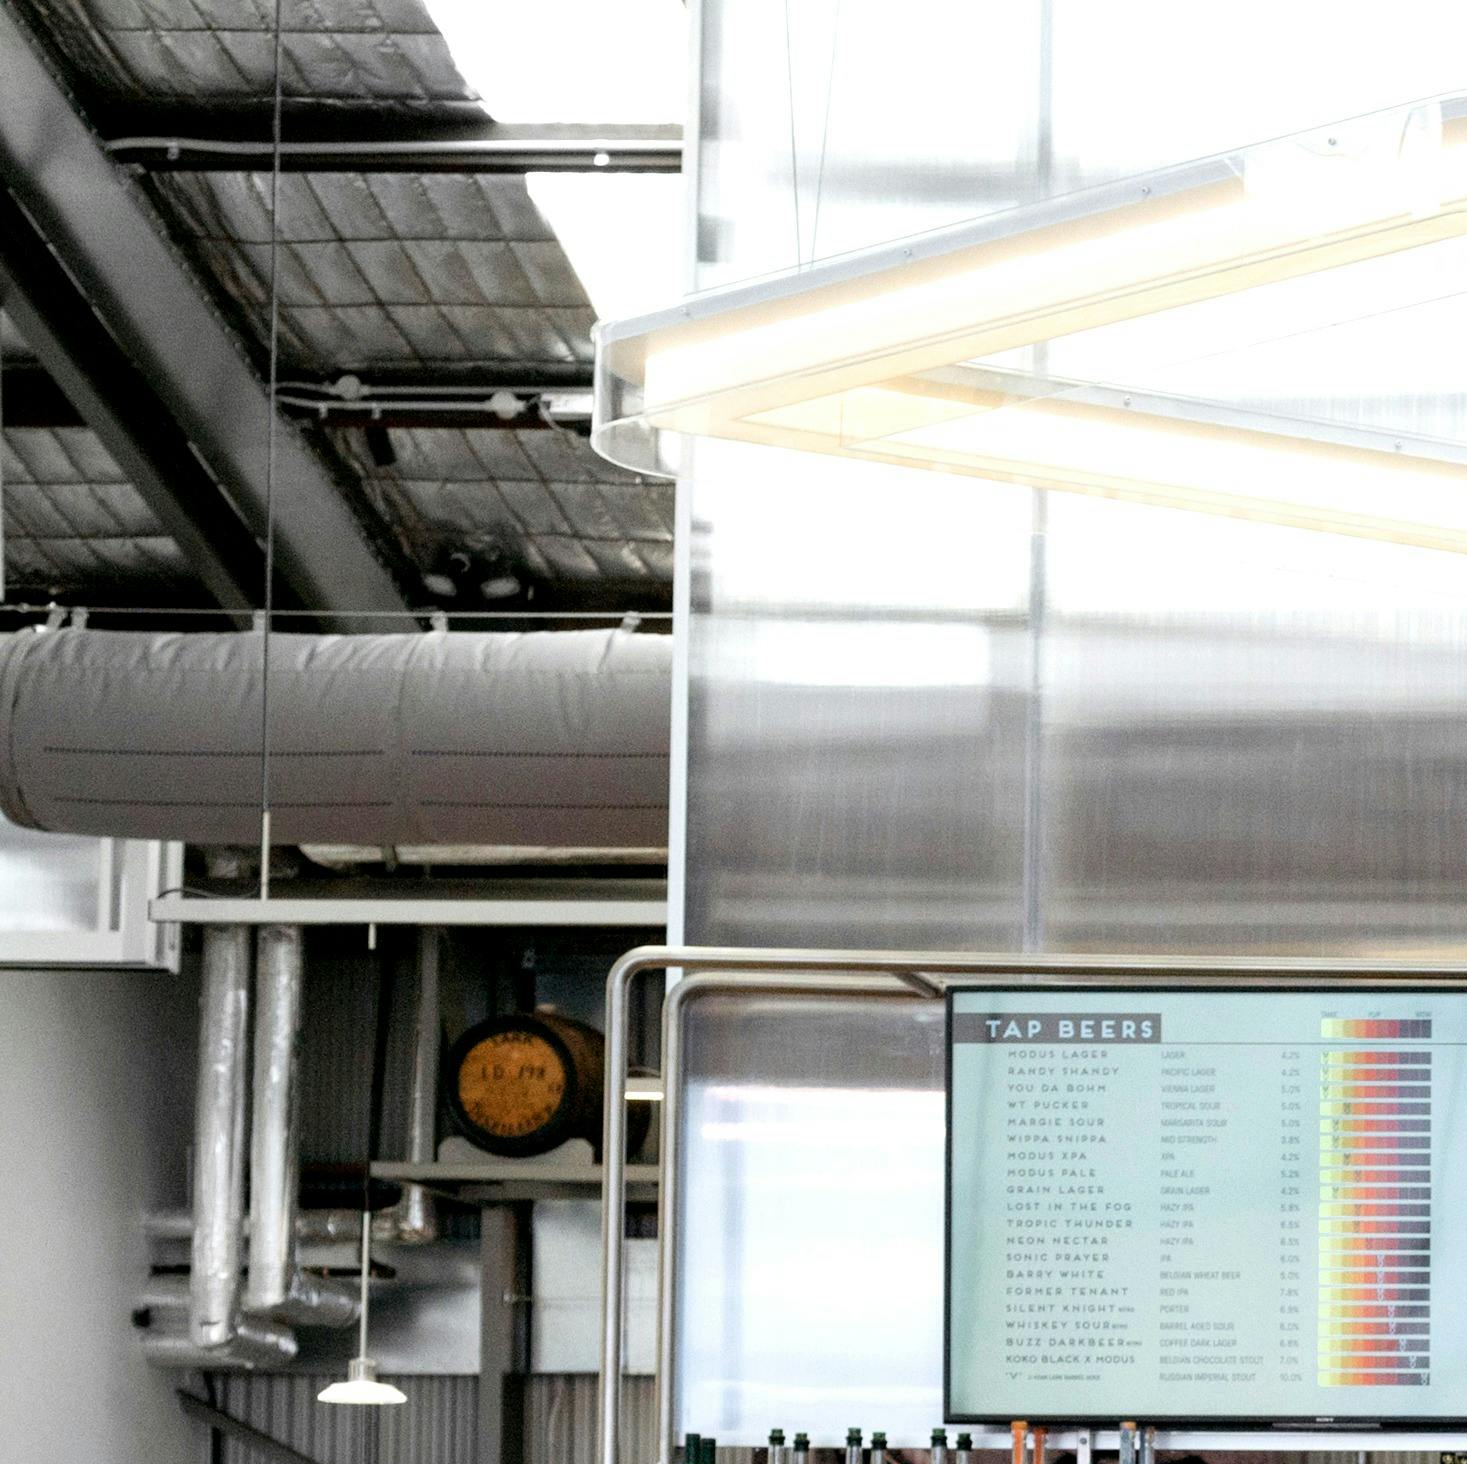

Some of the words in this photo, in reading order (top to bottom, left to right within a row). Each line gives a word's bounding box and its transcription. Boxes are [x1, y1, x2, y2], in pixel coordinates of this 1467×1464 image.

[986, 1020, 1042, 1038] TAP
[1059, 1020, 1154, 1038] BEERS
[1007, 1203, 1040, 1211] LOST
[1048, 1203, 1062, 1211] IN
[1071, 1203, 1097, 1211] THE
[1106, 1203, 1131, 1211] FOG
